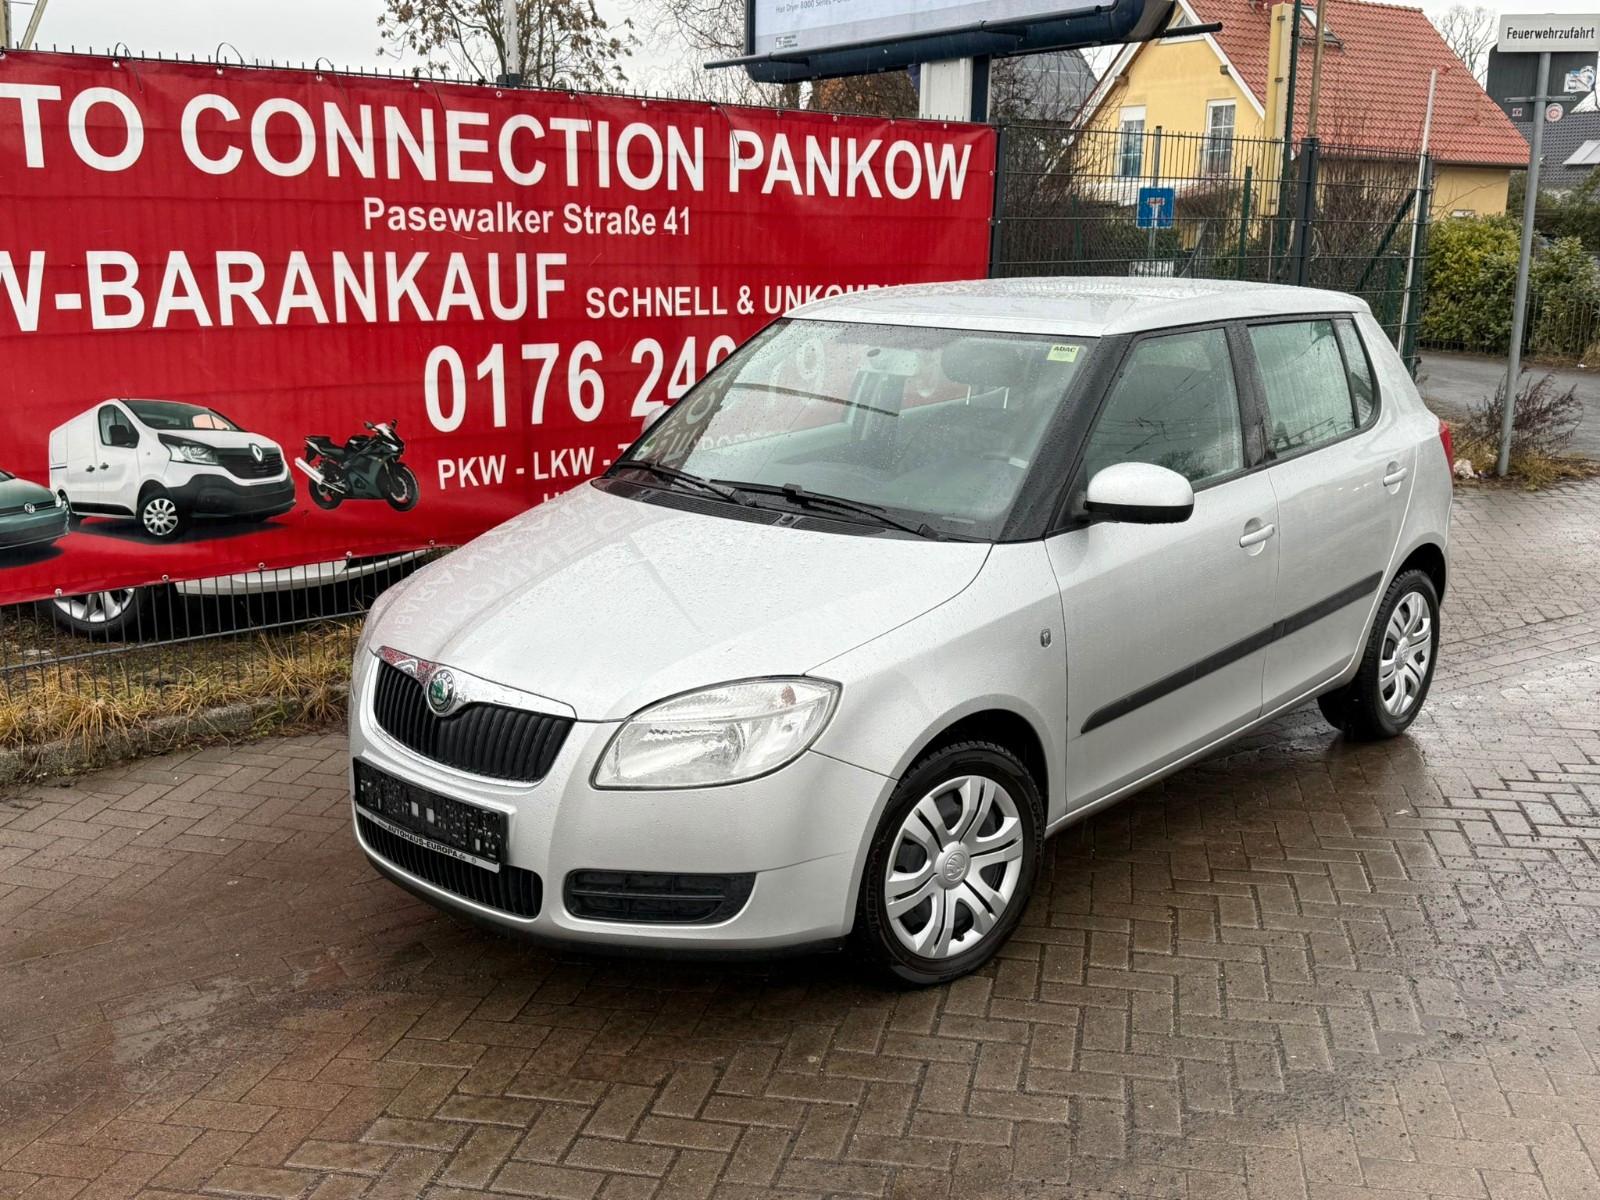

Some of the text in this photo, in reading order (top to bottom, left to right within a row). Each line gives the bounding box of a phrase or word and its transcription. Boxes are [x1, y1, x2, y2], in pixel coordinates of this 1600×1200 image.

[1506, 26, 1595, 40] Feuerwehrzufahrt
[0, 82, 972, 201] TO CONNECTION PANKOW
[363, 196, 690, 236] Pasewalker Straße 41
[586, 286, 728, 319] SCHNELL
[736, 285, 755, 315] &
[424, 340, 605, 433] 0176
[437, 454, 507, 490] PKW
[533, 446, 595, 480] LKW
